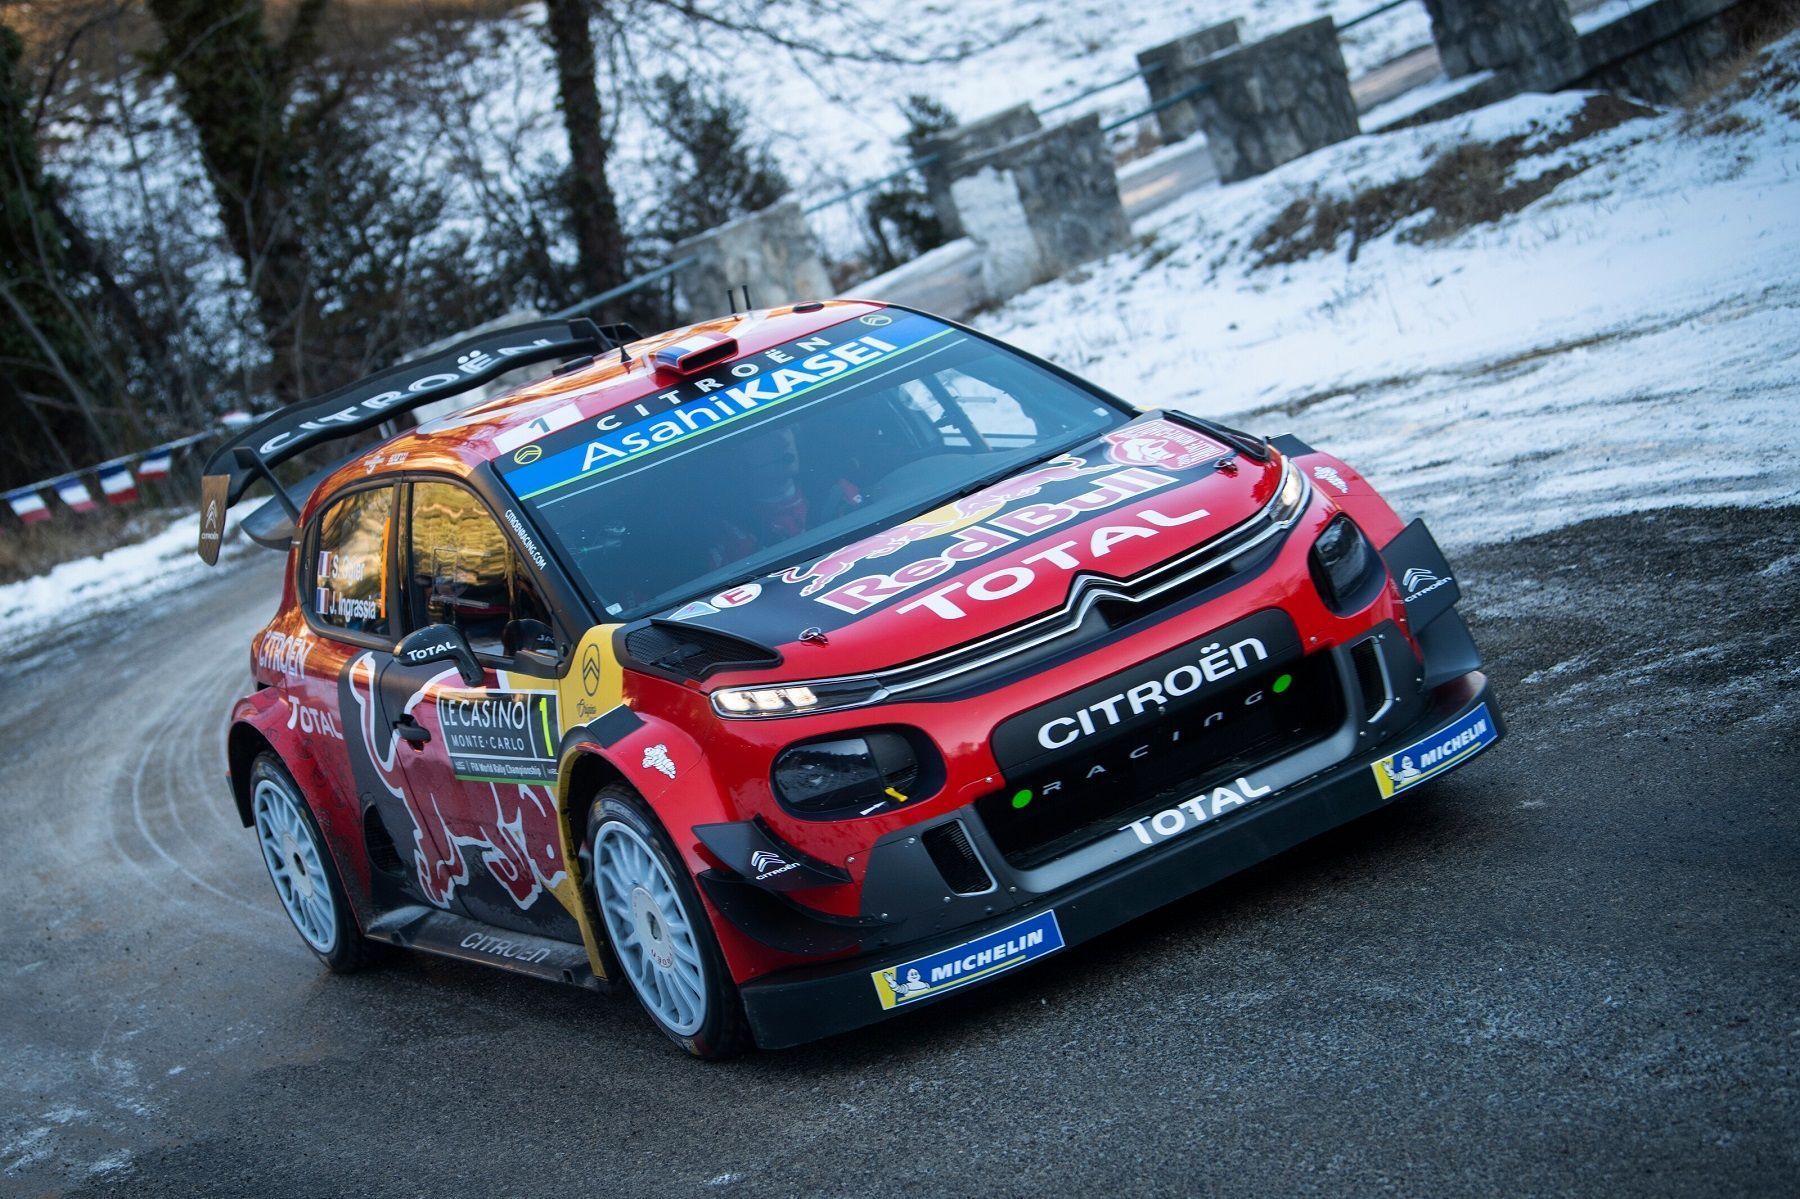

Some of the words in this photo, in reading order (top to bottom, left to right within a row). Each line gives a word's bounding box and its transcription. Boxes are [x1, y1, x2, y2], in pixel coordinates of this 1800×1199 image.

[596, 335, 830, 432] CITROËN
[528, 417, 551, 433] 1
[814, 526, 1020, 615] Red
[985, 467, 1179, 537] Bull
[897, 508, 1211, 620] TOTAL
[338, 592, 376, 623] Ingrassia
[407, 641, 457, 661] TOTAL
[287, 695, 344, 740] TOTAL
[440, 699, 459, 727] LE
[459, 699, 525, 730] CASINO
[1037, 637, 1269, 750] CITROËN
[539, 697, 554, 757] 1
[1420, 718, 1487, 768] MICHELIN
[1117, 777, 1272, 846] TOTAL
[931, 928, 1044, 983] MICHELIN
